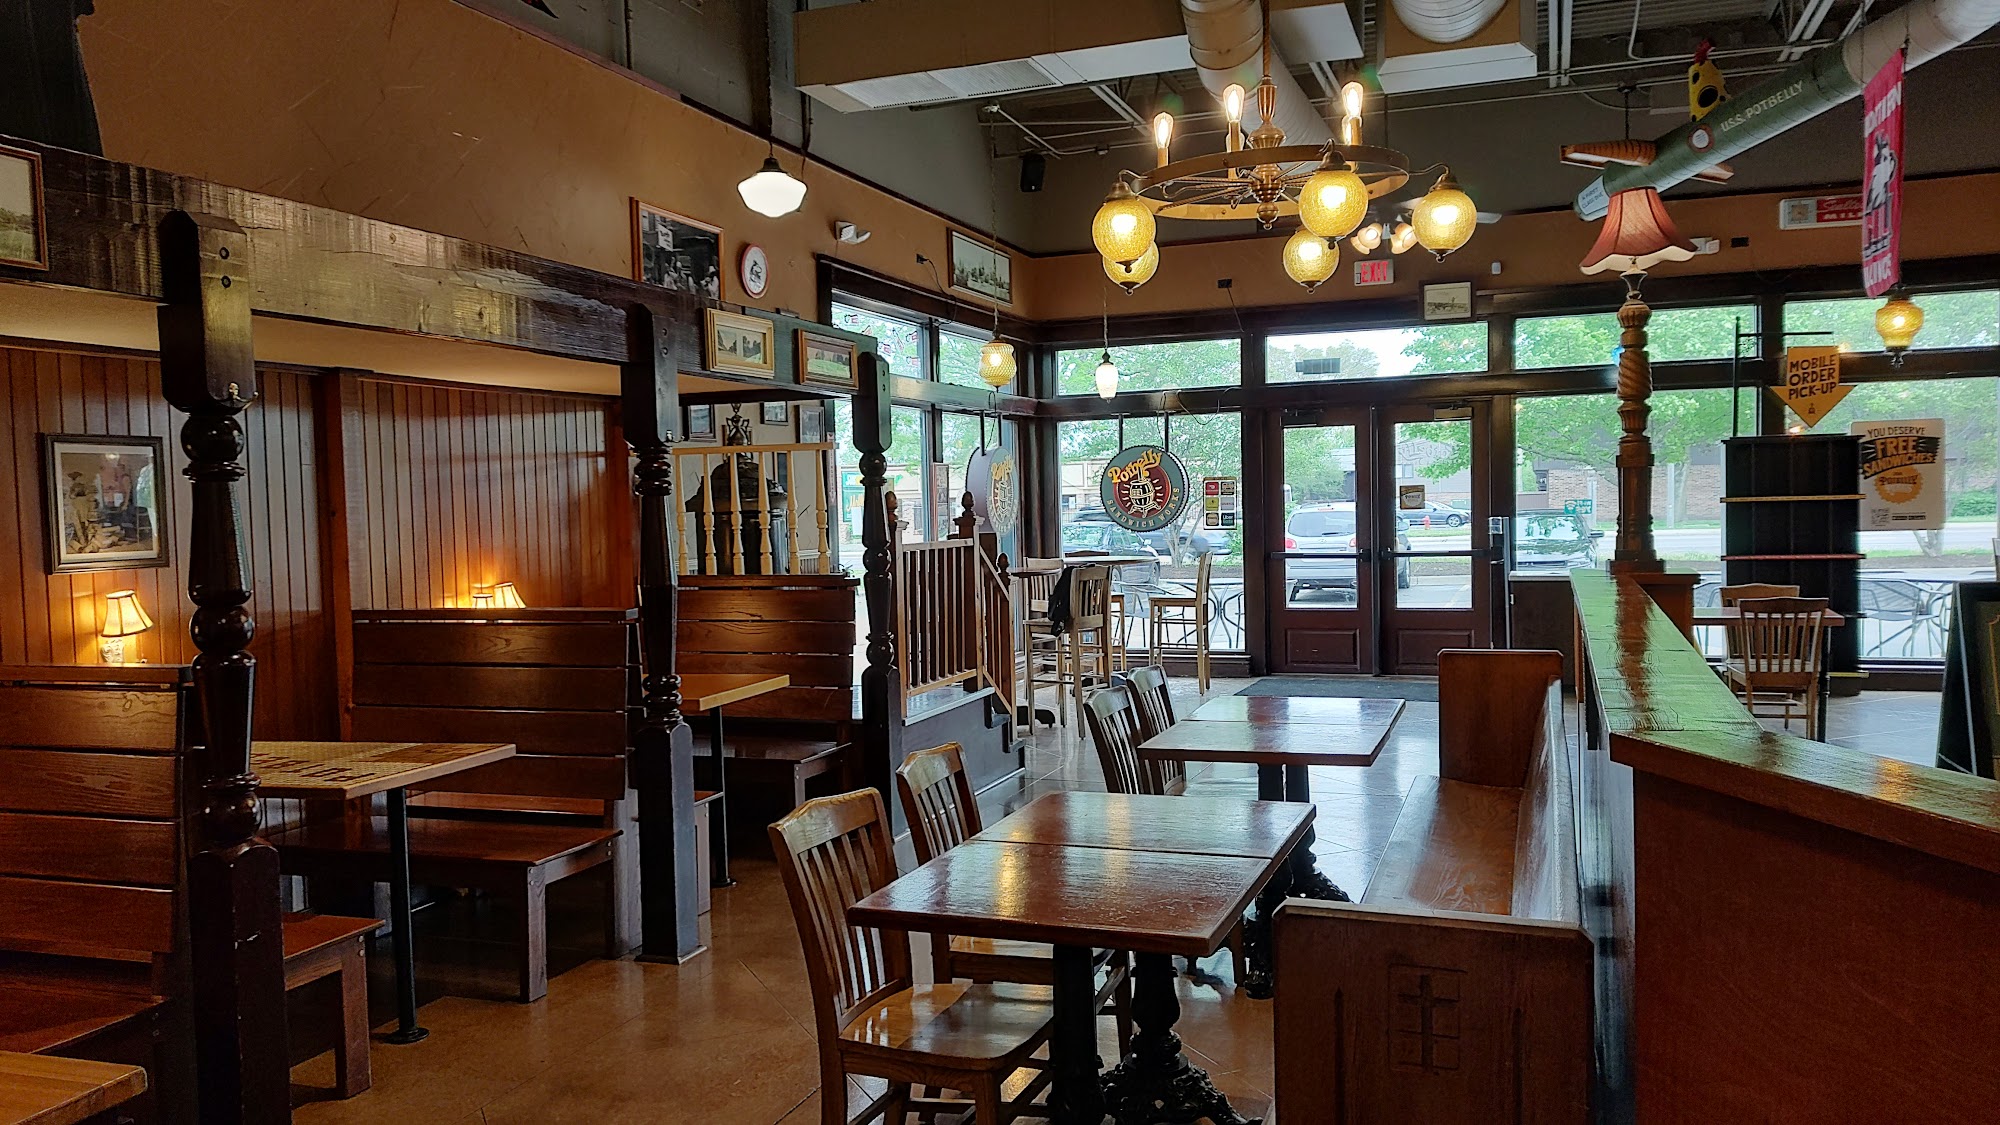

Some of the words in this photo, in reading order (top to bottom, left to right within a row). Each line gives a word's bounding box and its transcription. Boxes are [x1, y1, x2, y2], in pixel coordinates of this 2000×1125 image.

[1745, 79, 1803, 119] POTBELLY
[1360, 261, 1388, 283] EXIT
[1790, 354, 1836, 373] MOBILE
[1789, 367, 1836, 386] ORDER
[1788, 382, 1837, 400] PICK-UP
[1867, 427, 1886, 438] YOU
[1888, 426, 1926, 436] DESERVE
[1874, 437, 1918, 458] FREE
[1108, 449, 1162, 483] Potbelly
[1107, 499, 1154, 528] SANDWICH
[1158, 487, 1180, 521] WORKS
